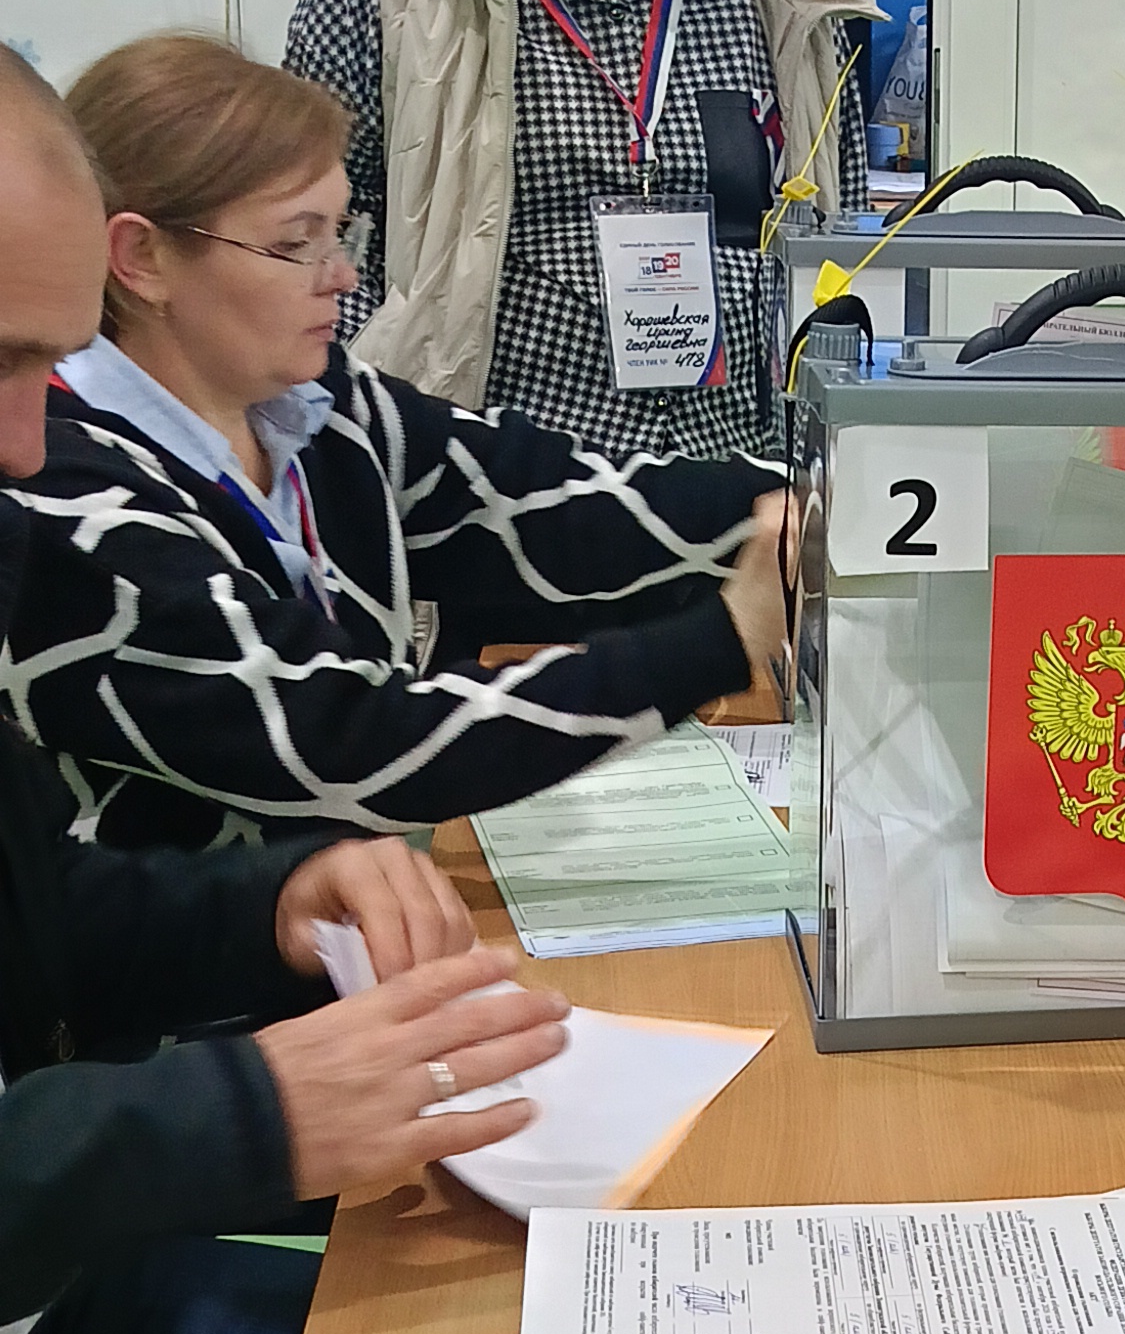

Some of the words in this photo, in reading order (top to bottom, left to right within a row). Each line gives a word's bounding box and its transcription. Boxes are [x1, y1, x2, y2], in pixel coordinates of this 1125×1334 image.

[641, 266, 652, 276] 18
[653, 260, 664, 270] 19
[665, 256, 679, 266] 20
[1043, 322, 1098, 335] ИРАТЕЛЬНЫЙ
[675, 352, 705, 367] 478
[886, 479, 937, 556] 2
